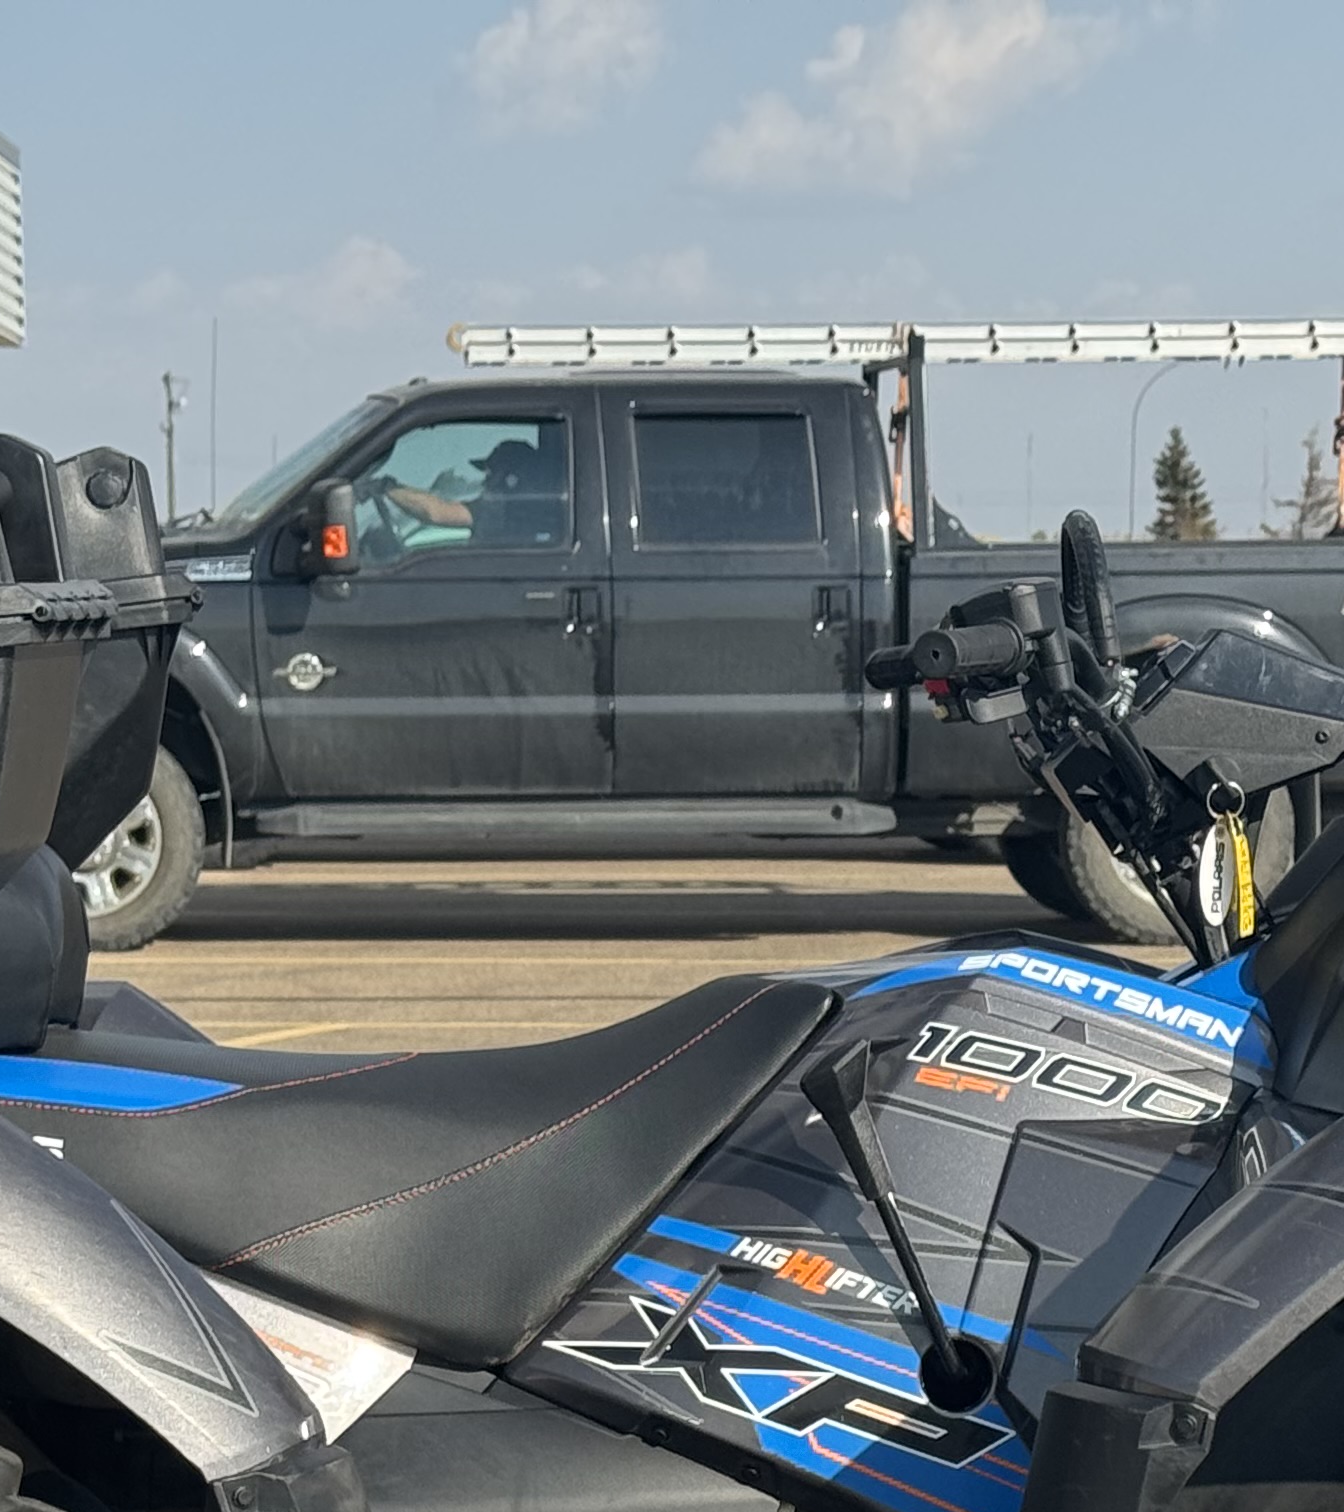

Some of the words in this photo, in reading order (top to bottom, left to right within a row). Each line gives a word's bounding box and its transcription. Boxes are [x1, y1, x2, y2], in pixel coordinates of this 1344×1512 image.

[1210, 841, 1226, 914] POLARIS
[957, 952, 1244, 1049] SPORTSMAN
[906, 1021, 1228, 1126] 1000
[913, 1066, 1011, 1103] EFI
